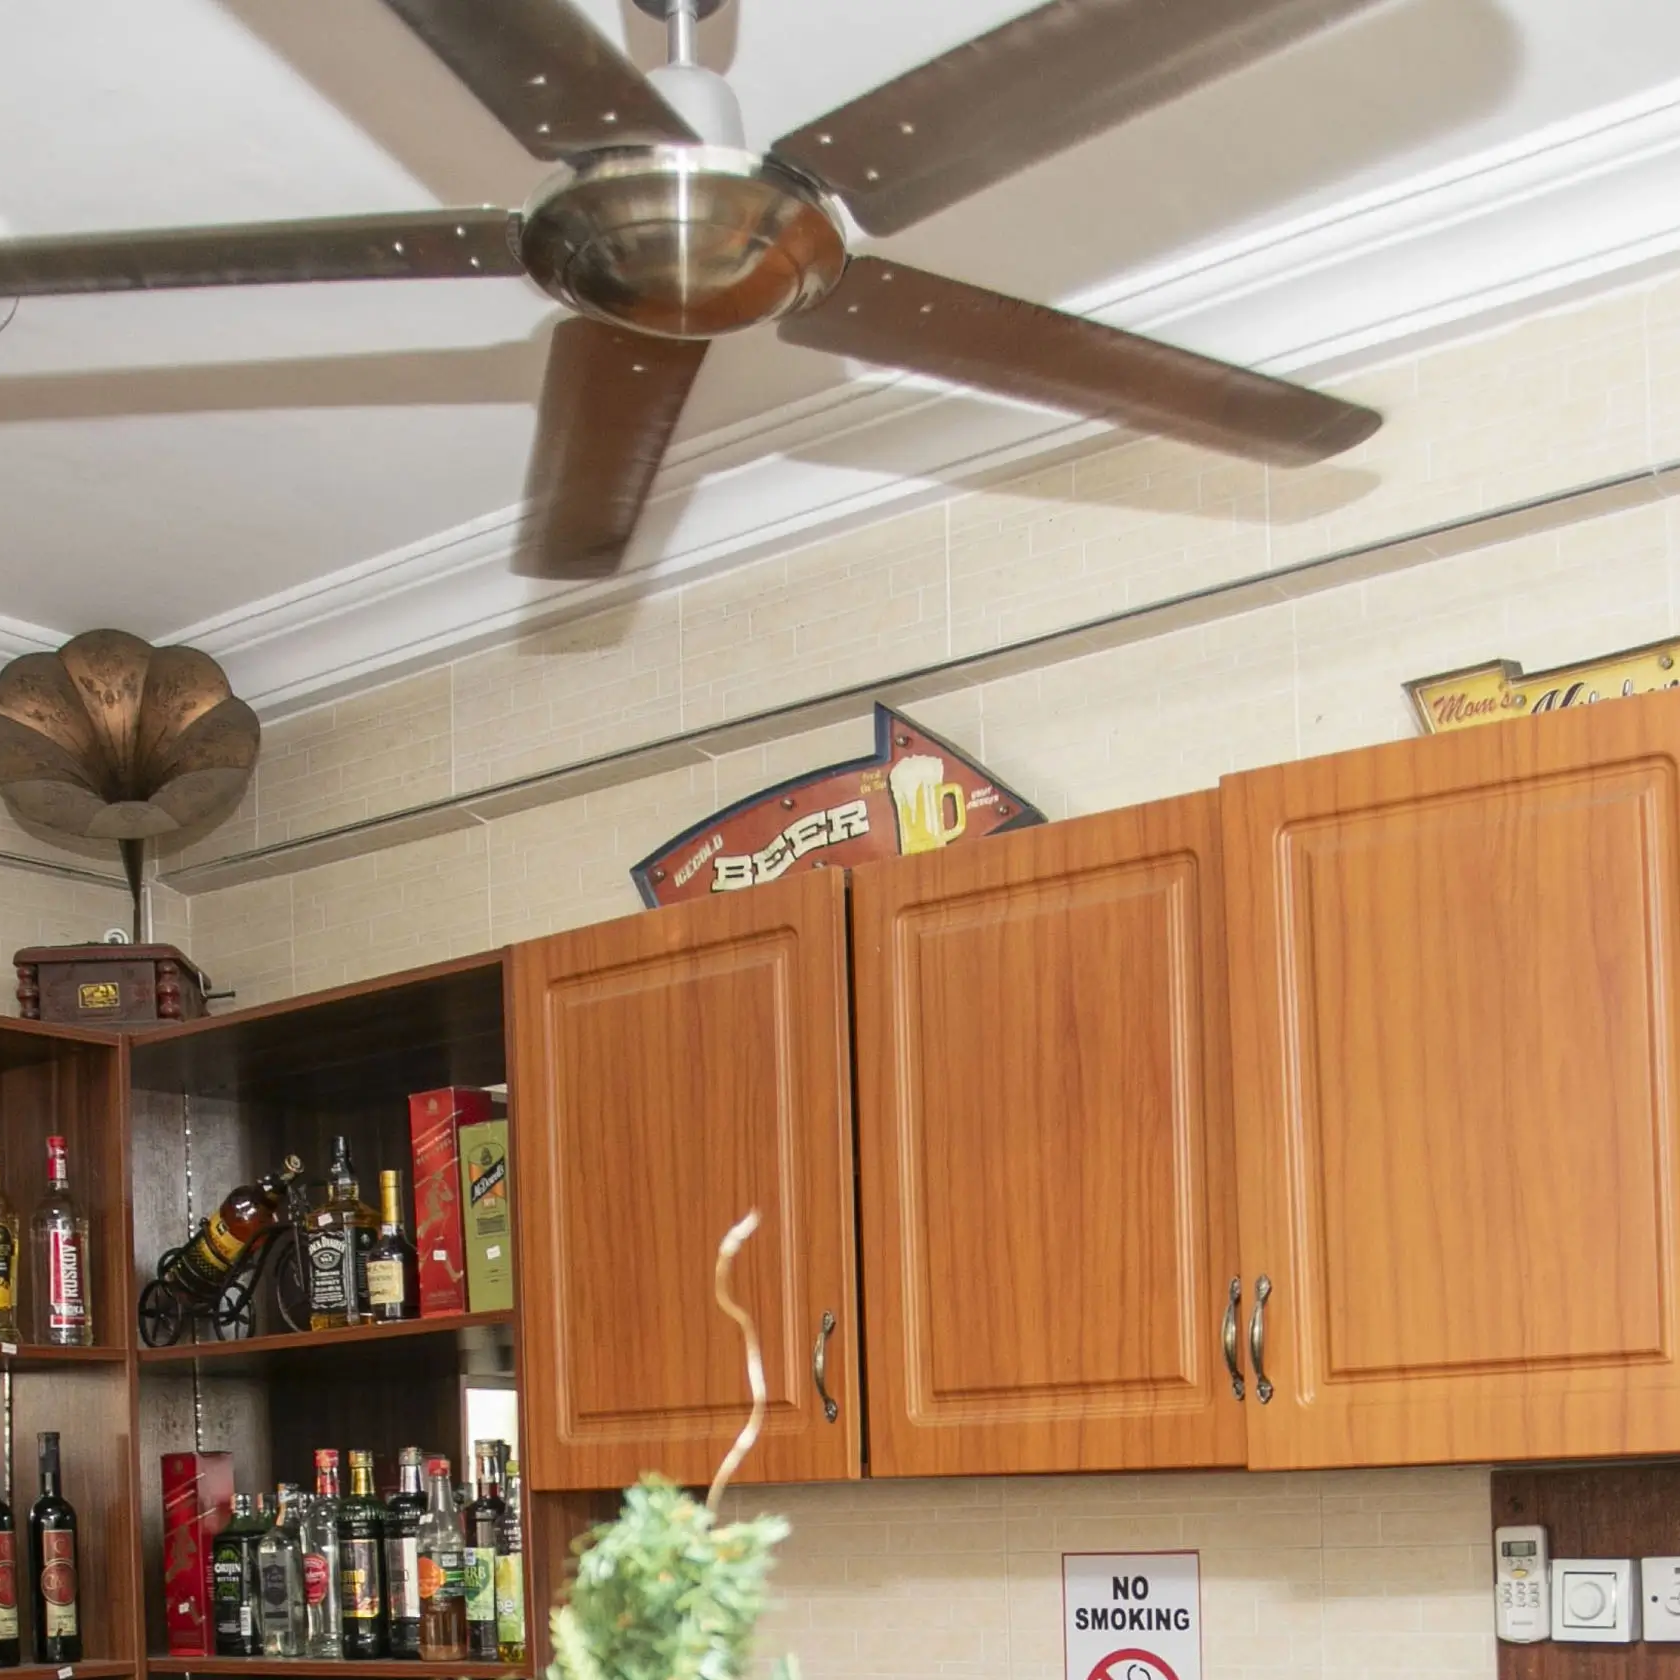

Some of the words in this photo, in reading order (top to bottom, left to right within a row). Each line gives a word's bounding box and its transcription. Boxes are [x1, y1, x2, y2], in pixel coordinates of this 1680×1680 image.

[711, 799, 870, 893] BEER
[62, 1244, 79, 1298] RUSKOV
[1111, 1575, 1150, 1601] NO
[1075, 1607, 1191, 1631] SMOKING
